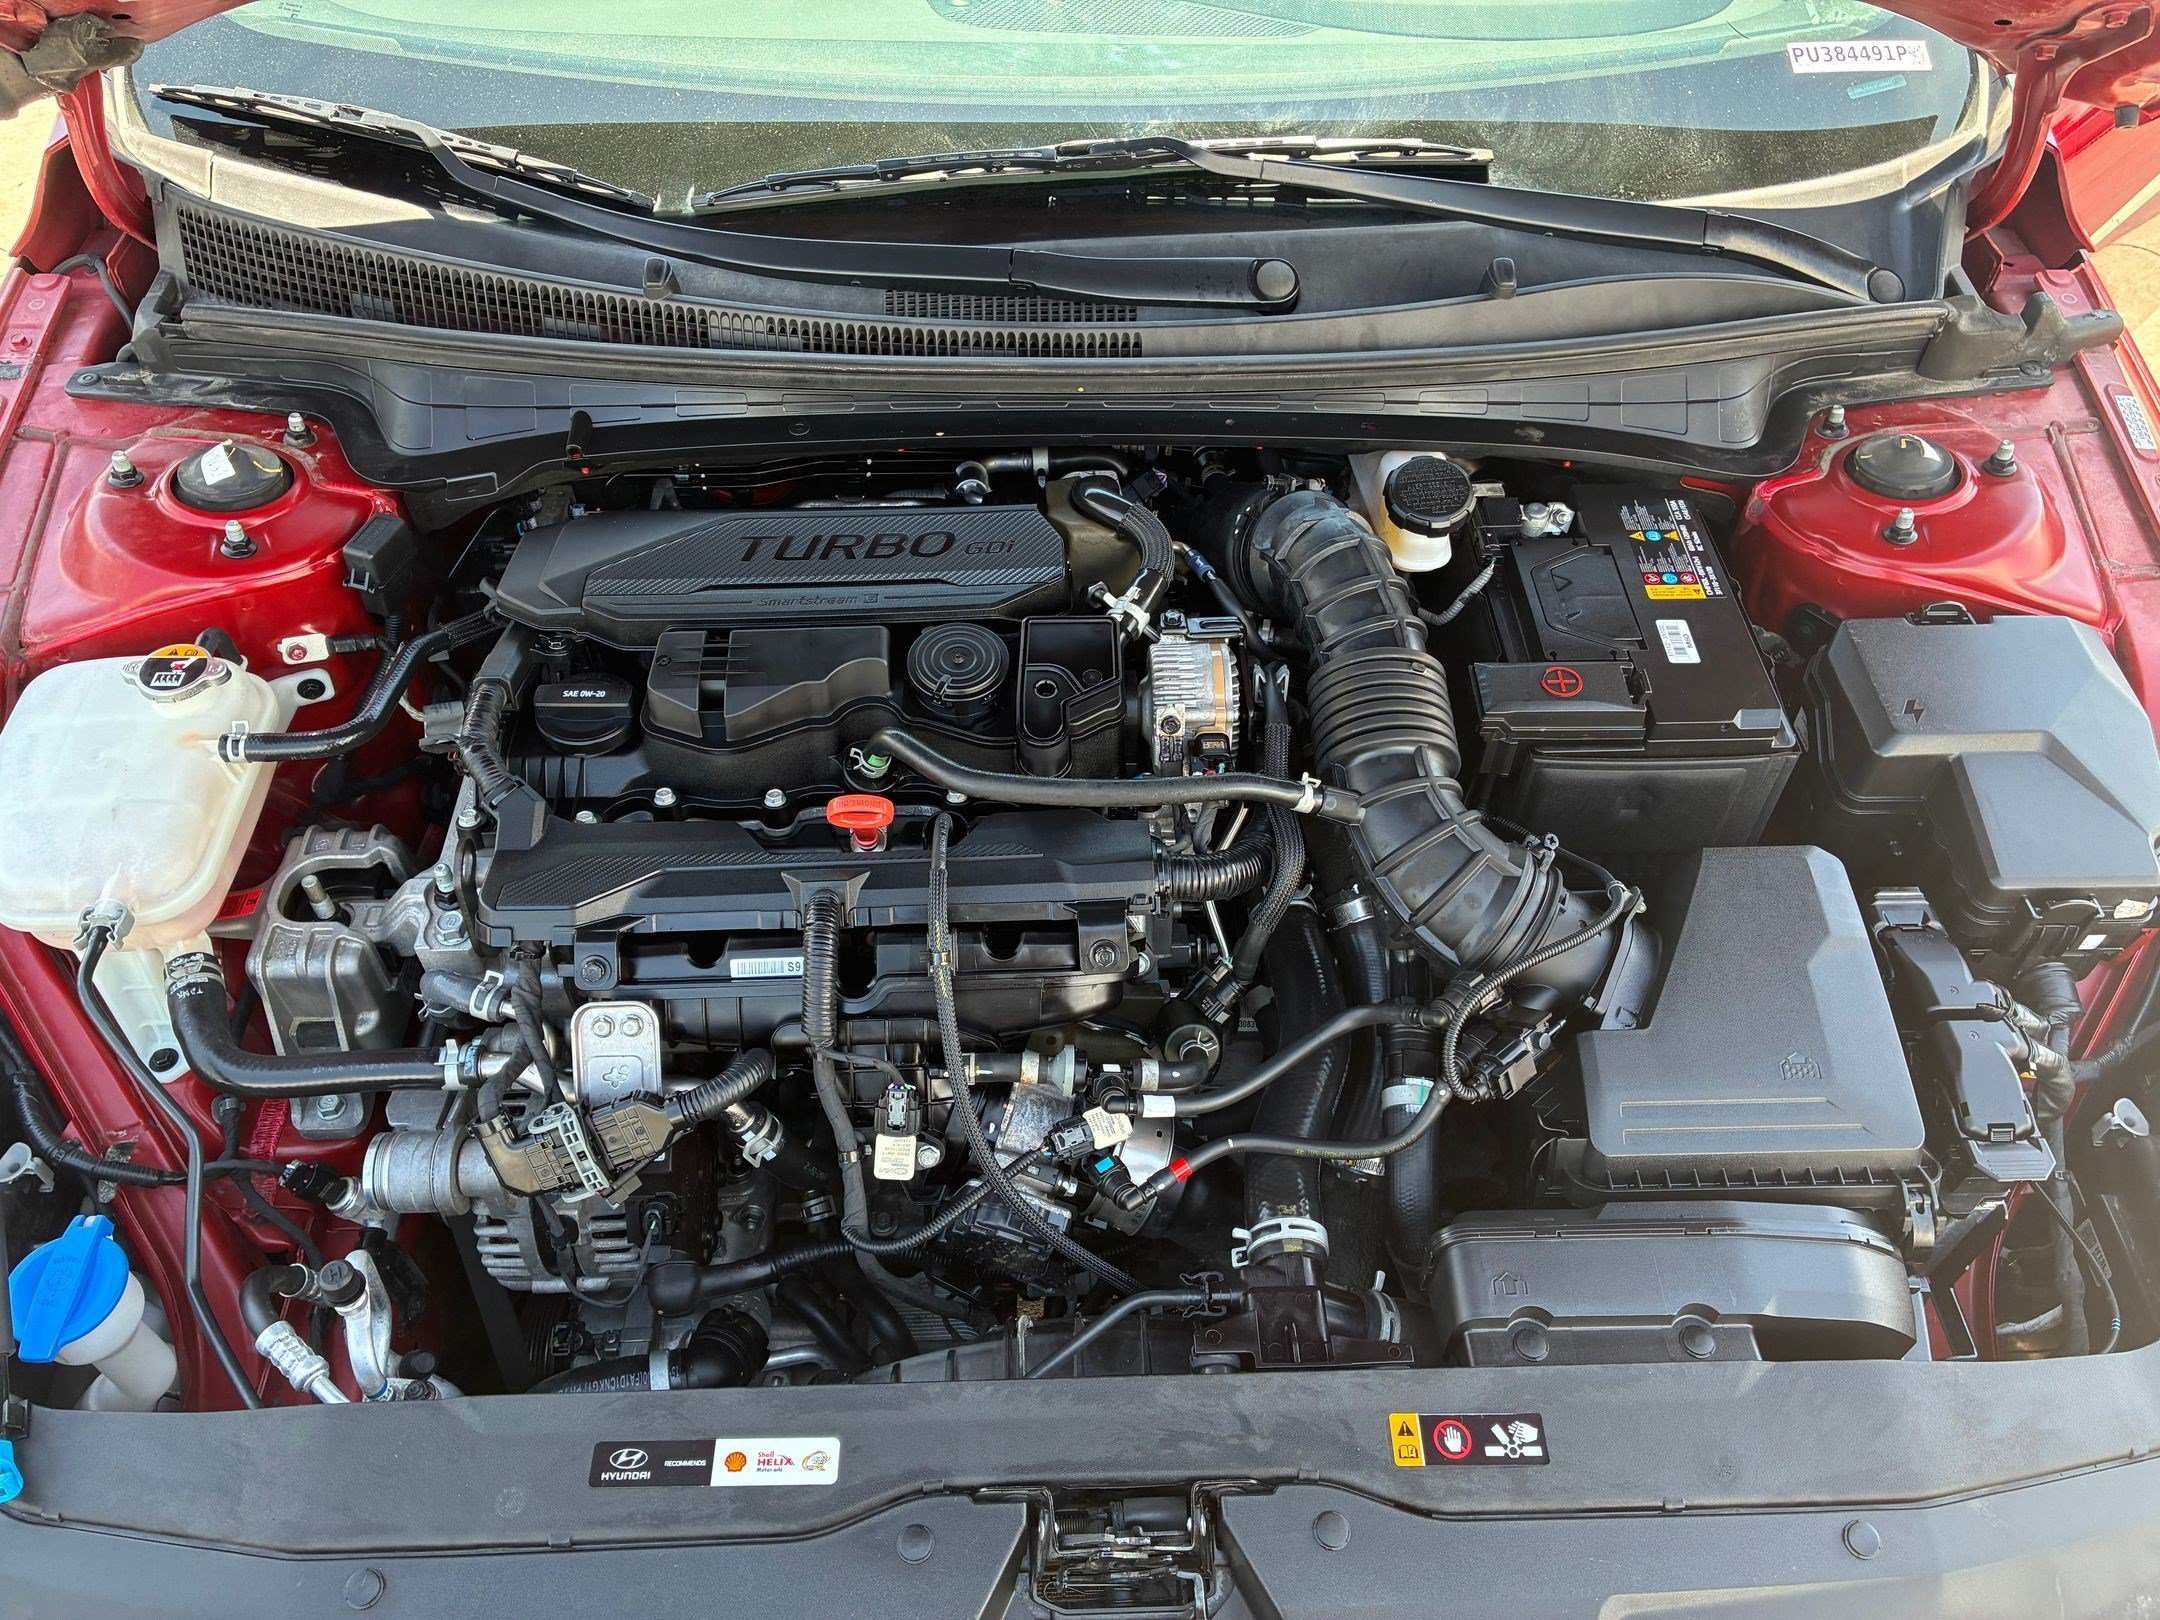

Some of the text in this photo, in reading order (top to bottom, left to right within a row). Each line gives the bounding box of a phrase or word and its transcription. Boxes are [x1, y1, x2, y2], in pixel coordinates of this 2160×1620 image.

[1792, 45, 1907, 63] PU384491P
[739, 530, 956, 562] TURBO
[757, 595, 857, 607] Smartstream
[562, 690, 606, 698] SAE 0W-20
[758, 1451, 775, 1459] Shell
[664, 1459, 707, 1467] RECOMMENDS
[756, 1457, 795, 1467] HELIX
[601, 1471, 651, 1481] HYUNDAI
